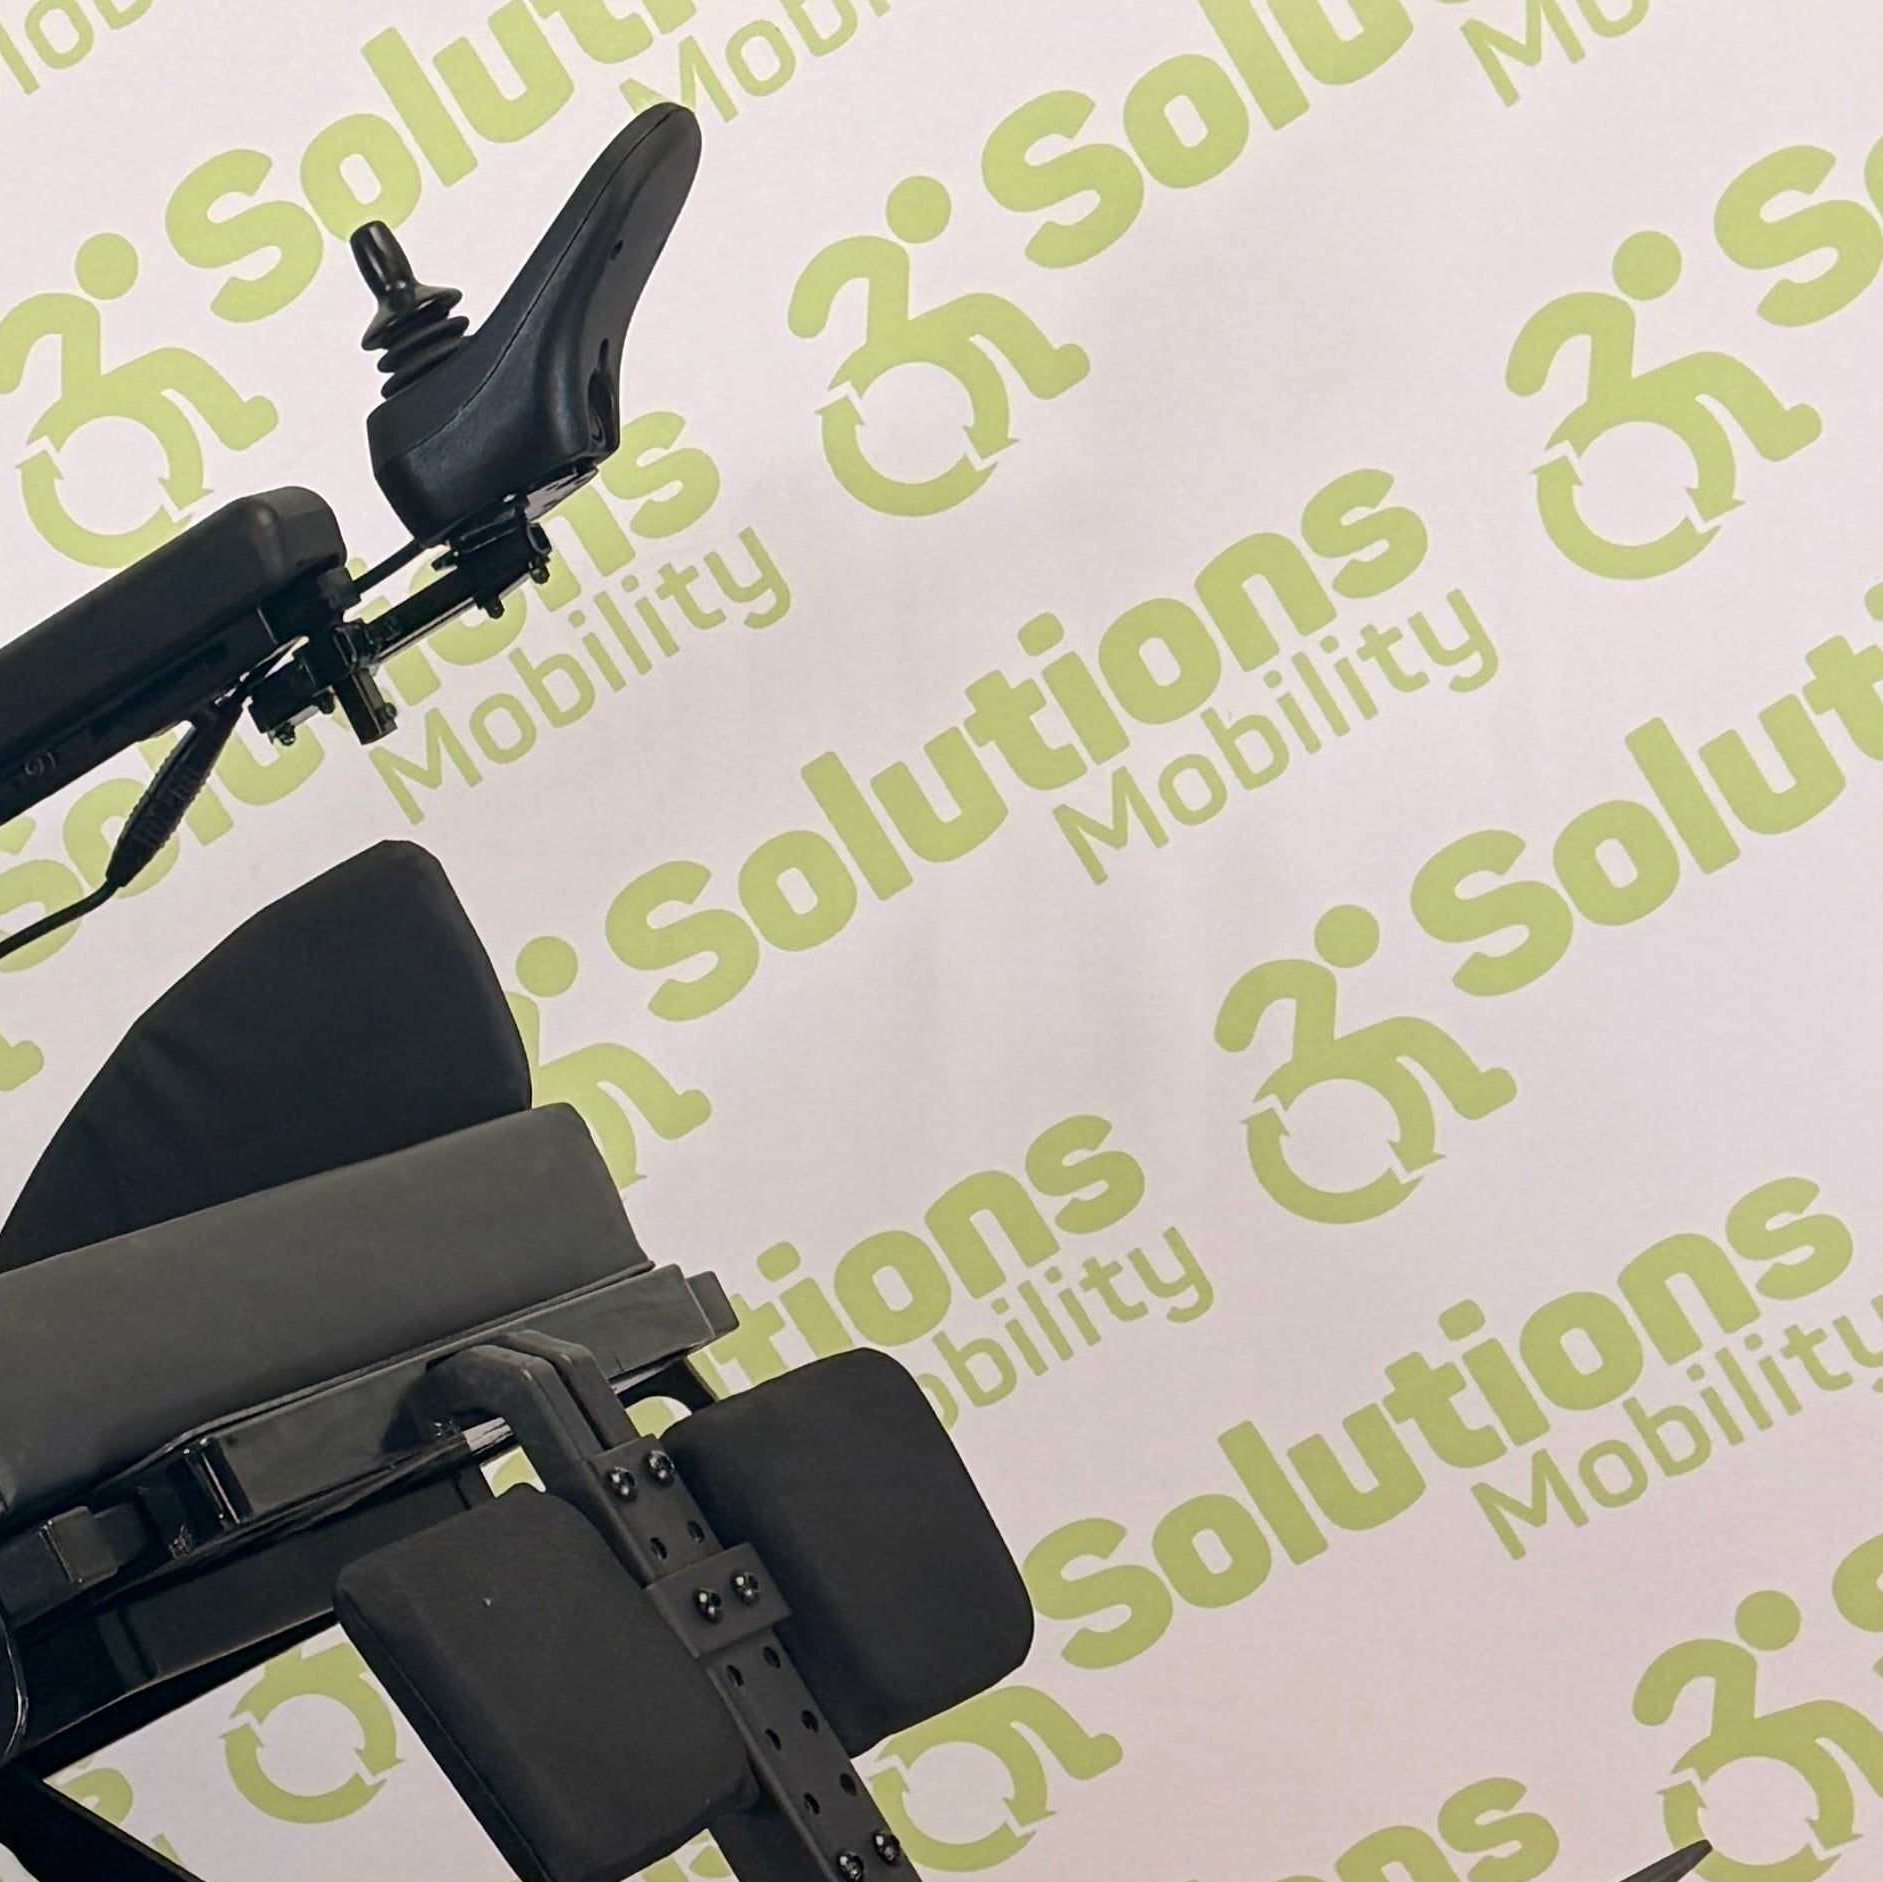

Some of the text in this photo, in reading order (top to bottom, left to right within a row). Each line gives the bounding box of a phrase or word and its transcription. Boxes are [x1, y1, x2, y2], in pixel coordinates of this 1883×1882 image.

[163, 0, 696, 325] Solut
[368, 529, 793, 824] Mobility
[603, 467, 1430, 1024] Solutions
[1052, 589, 1500, 885] Mobility
[1409, 582, 1883, 999] Solut
[1019, 1176, 1856, 1672] Solutions
